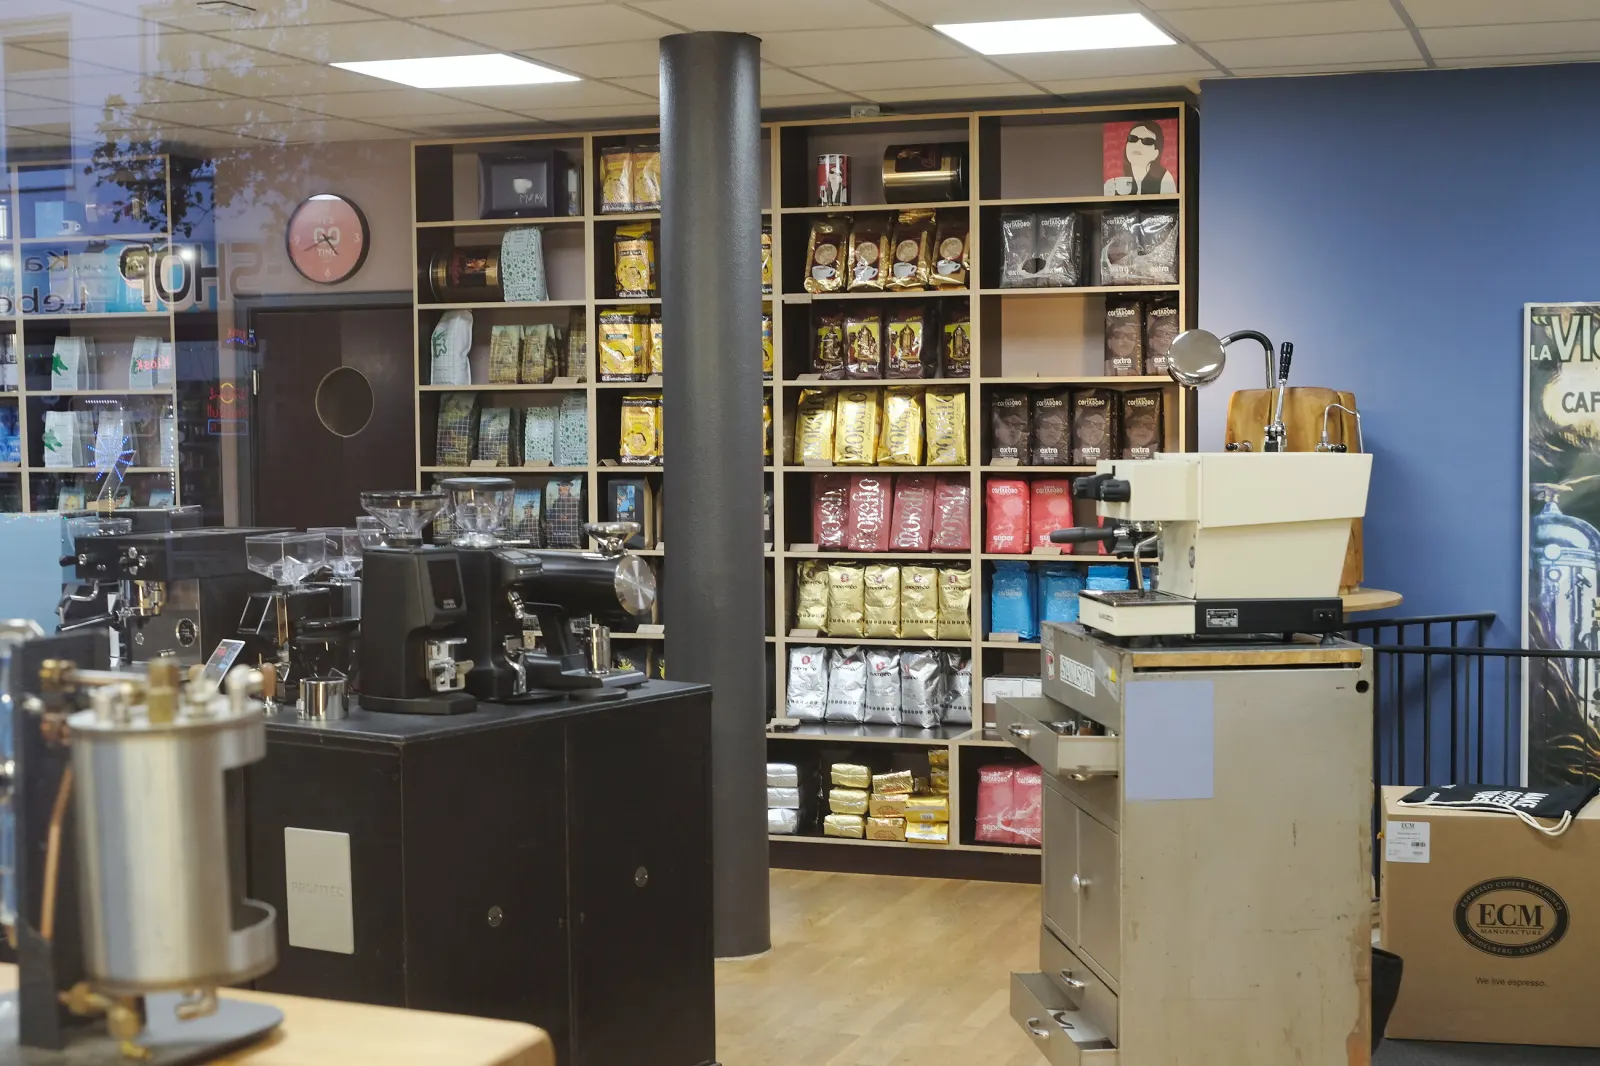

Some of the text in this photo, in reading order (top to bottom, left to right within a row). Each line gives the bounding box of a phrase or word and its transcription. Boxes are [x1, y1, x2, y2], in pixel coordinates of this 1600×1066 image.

[313, 226, 340, 246] GO
[354, 232, 361, 243] 3
[324, 267, 331, 277] 6
[1530, 344, 1552, 361] LA
[1113, 357, 1132, 365] extra
[1153, 356, 1166, 364] ext
[1000, 446, 1018, 454] extra
[1040, 446, 1058, 455] extra
[1081, 446, 1101, 454] extra
[1130, 445, 1150, 454] extra
[993, 534, 1014, 544] super
[1460, 880, 1564, 912] ESPRESSO COFFEE MACHINES
[1476, 903, 1545, 928] ECM
[1480, 928, 1543, 937] MANUFACTURE
[1519, 935, 1555, 955] GERMANY
[1475, 977, 1489, 986] We
[1490, 977, 1506, 987] live
